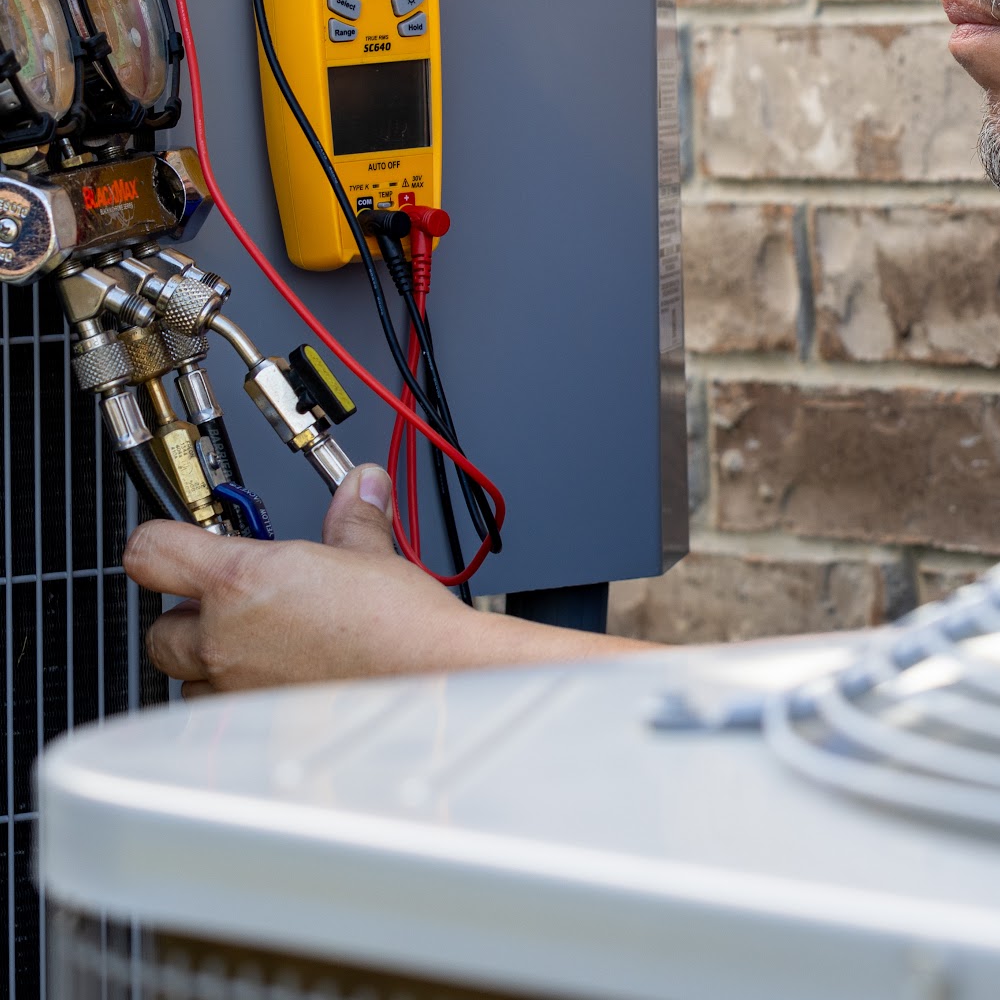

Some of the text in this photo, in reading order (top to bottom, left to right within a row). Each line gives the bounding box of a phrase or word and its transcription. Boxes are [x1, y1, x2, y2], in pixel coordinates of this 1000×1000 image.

[408, 23, 423, 31] Hold
[334, 29, 356, 37] Range
[363, 42, 392, 53] SC640
[368, 160, 401, 171] AUTO OFF
[411, 181, 424, 189] MAX
[379, 190, 393, 198] TEMP
[358, 198, 373, 206] COM
[259, 508, 274, 537] YELLOW
